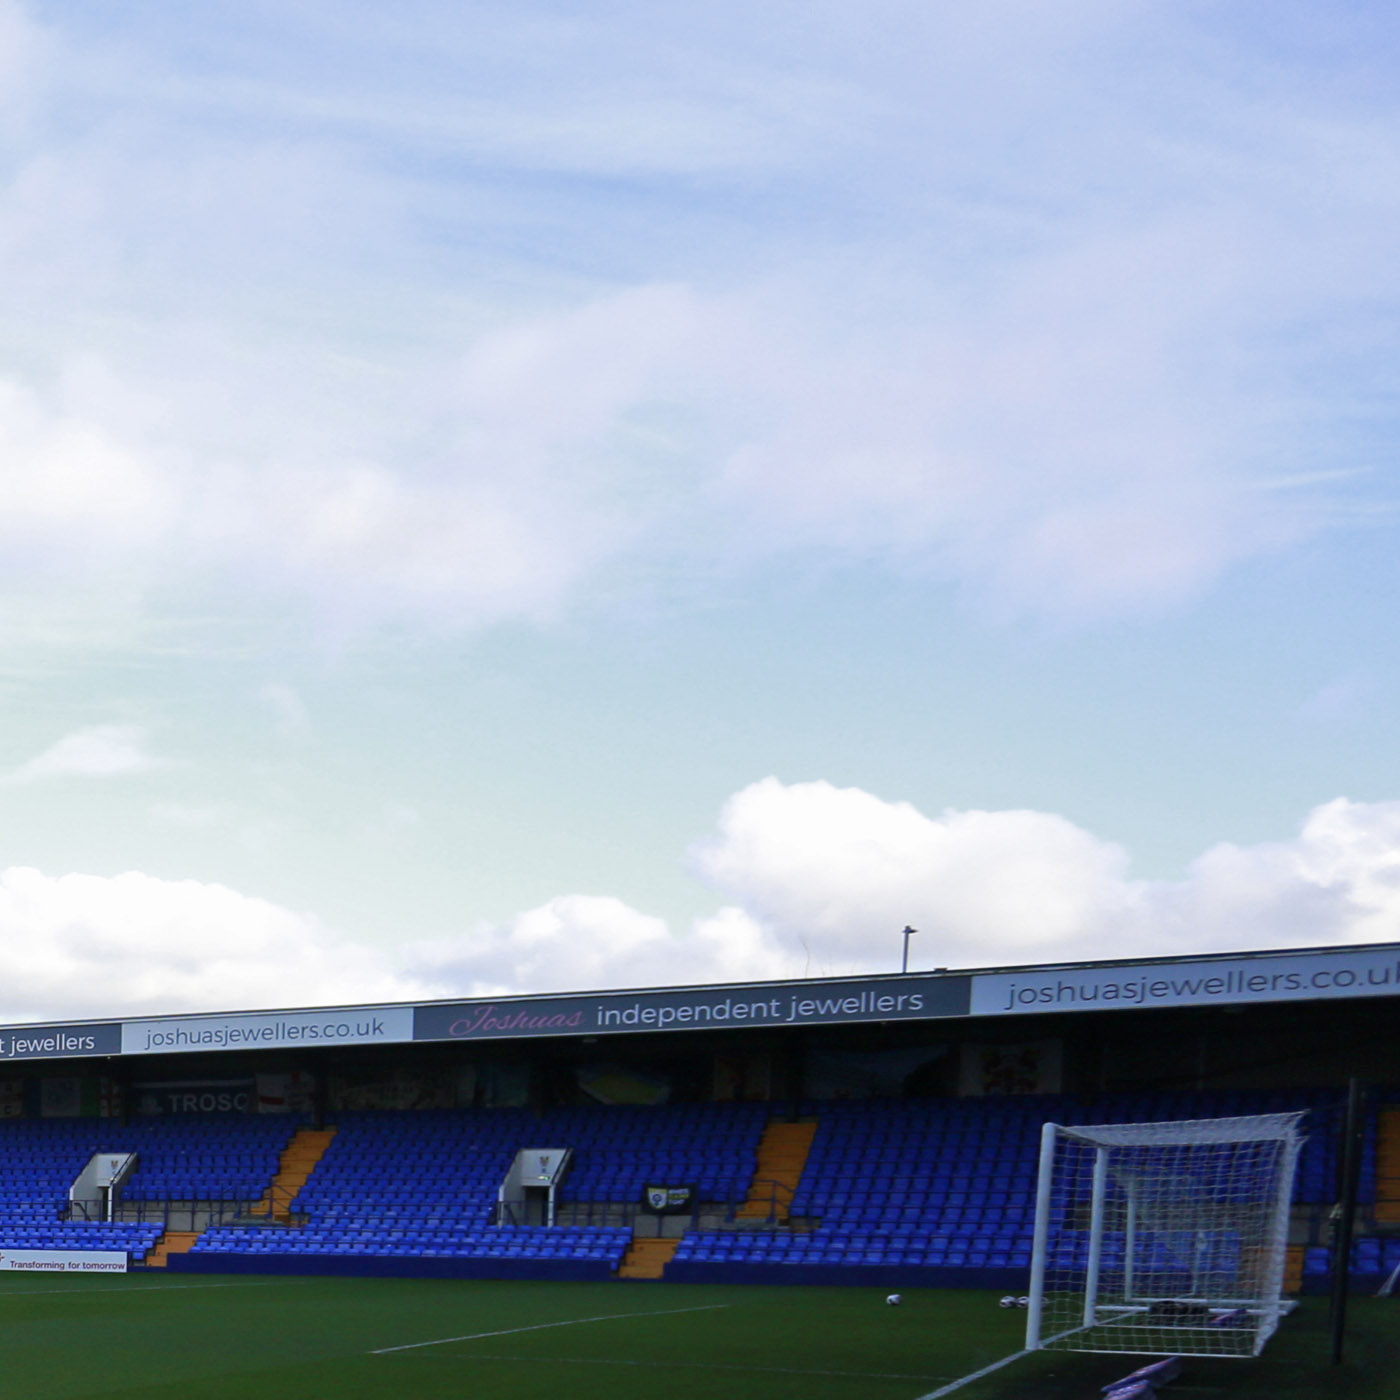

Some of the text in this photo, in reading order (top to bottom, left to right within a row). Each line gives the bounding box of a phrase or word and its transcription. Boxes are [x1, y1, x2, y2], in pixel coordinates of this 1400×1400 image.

[1005, 960, 1400, 1010] joshuasjewellers.co.u
[449, 991, 924, 1037] Joshuas independent jewellers
[9, 1033, 96, 1057] jewellers
[144, 1017, 385, 1050] joshuasjewellers.co.uk
[10, 1259, 126, 1270] Transforming for tomorrow
